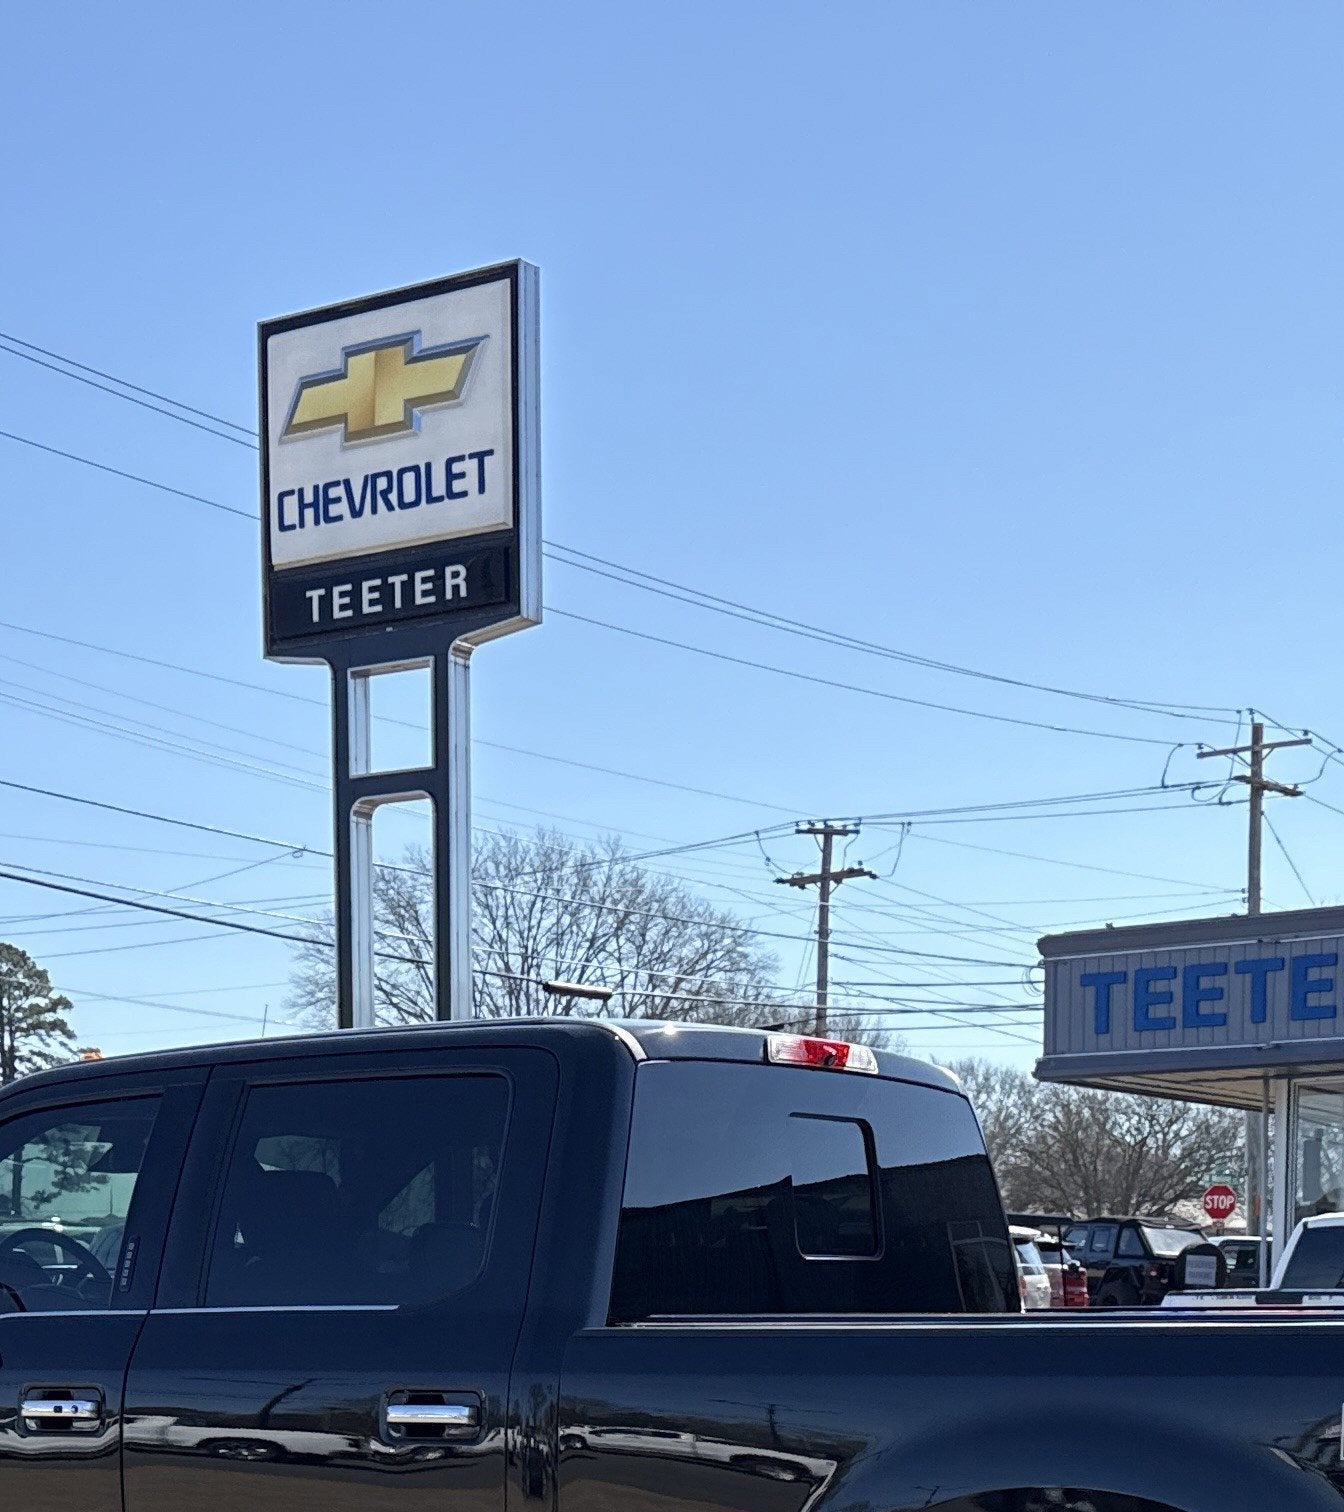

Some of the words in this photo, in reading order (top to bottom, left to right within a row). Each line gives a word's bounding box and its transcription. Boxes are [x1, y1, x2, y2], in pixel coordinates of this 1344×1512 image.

[277, 448, 495, 533] CHEVROLET
[305, 563, 468, 624] TEETER
[1205, 1195, 1235, 1210] STOP
